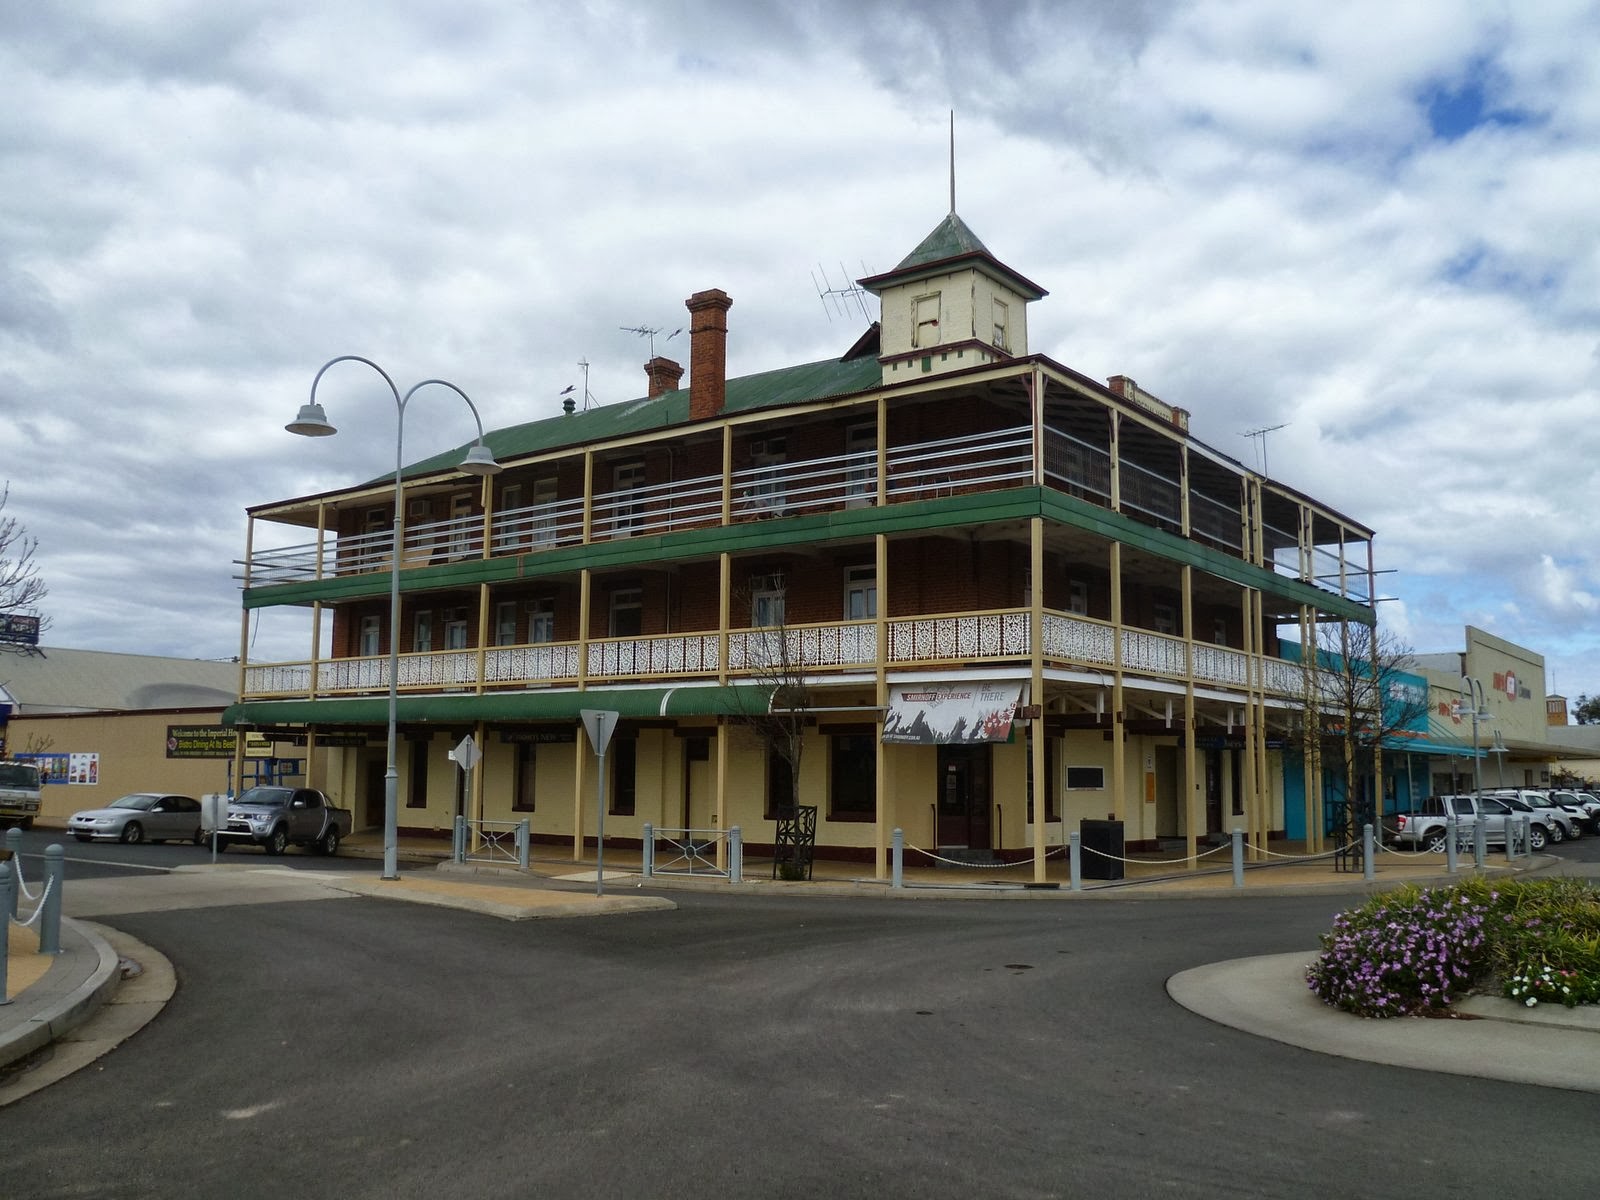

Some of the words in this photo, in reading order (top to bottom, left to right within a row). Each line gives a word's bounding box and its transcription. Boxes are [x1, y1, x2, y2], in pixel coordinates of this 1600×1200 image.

[982, 683, 993, 692] BE
[906, 693, 936, 701] SMIRNOFF
[937, 692, 972, 701] EXPERIENCE
[980, 691, 1006, 702] THERE
[207, 728, 228, 740] Imperial
